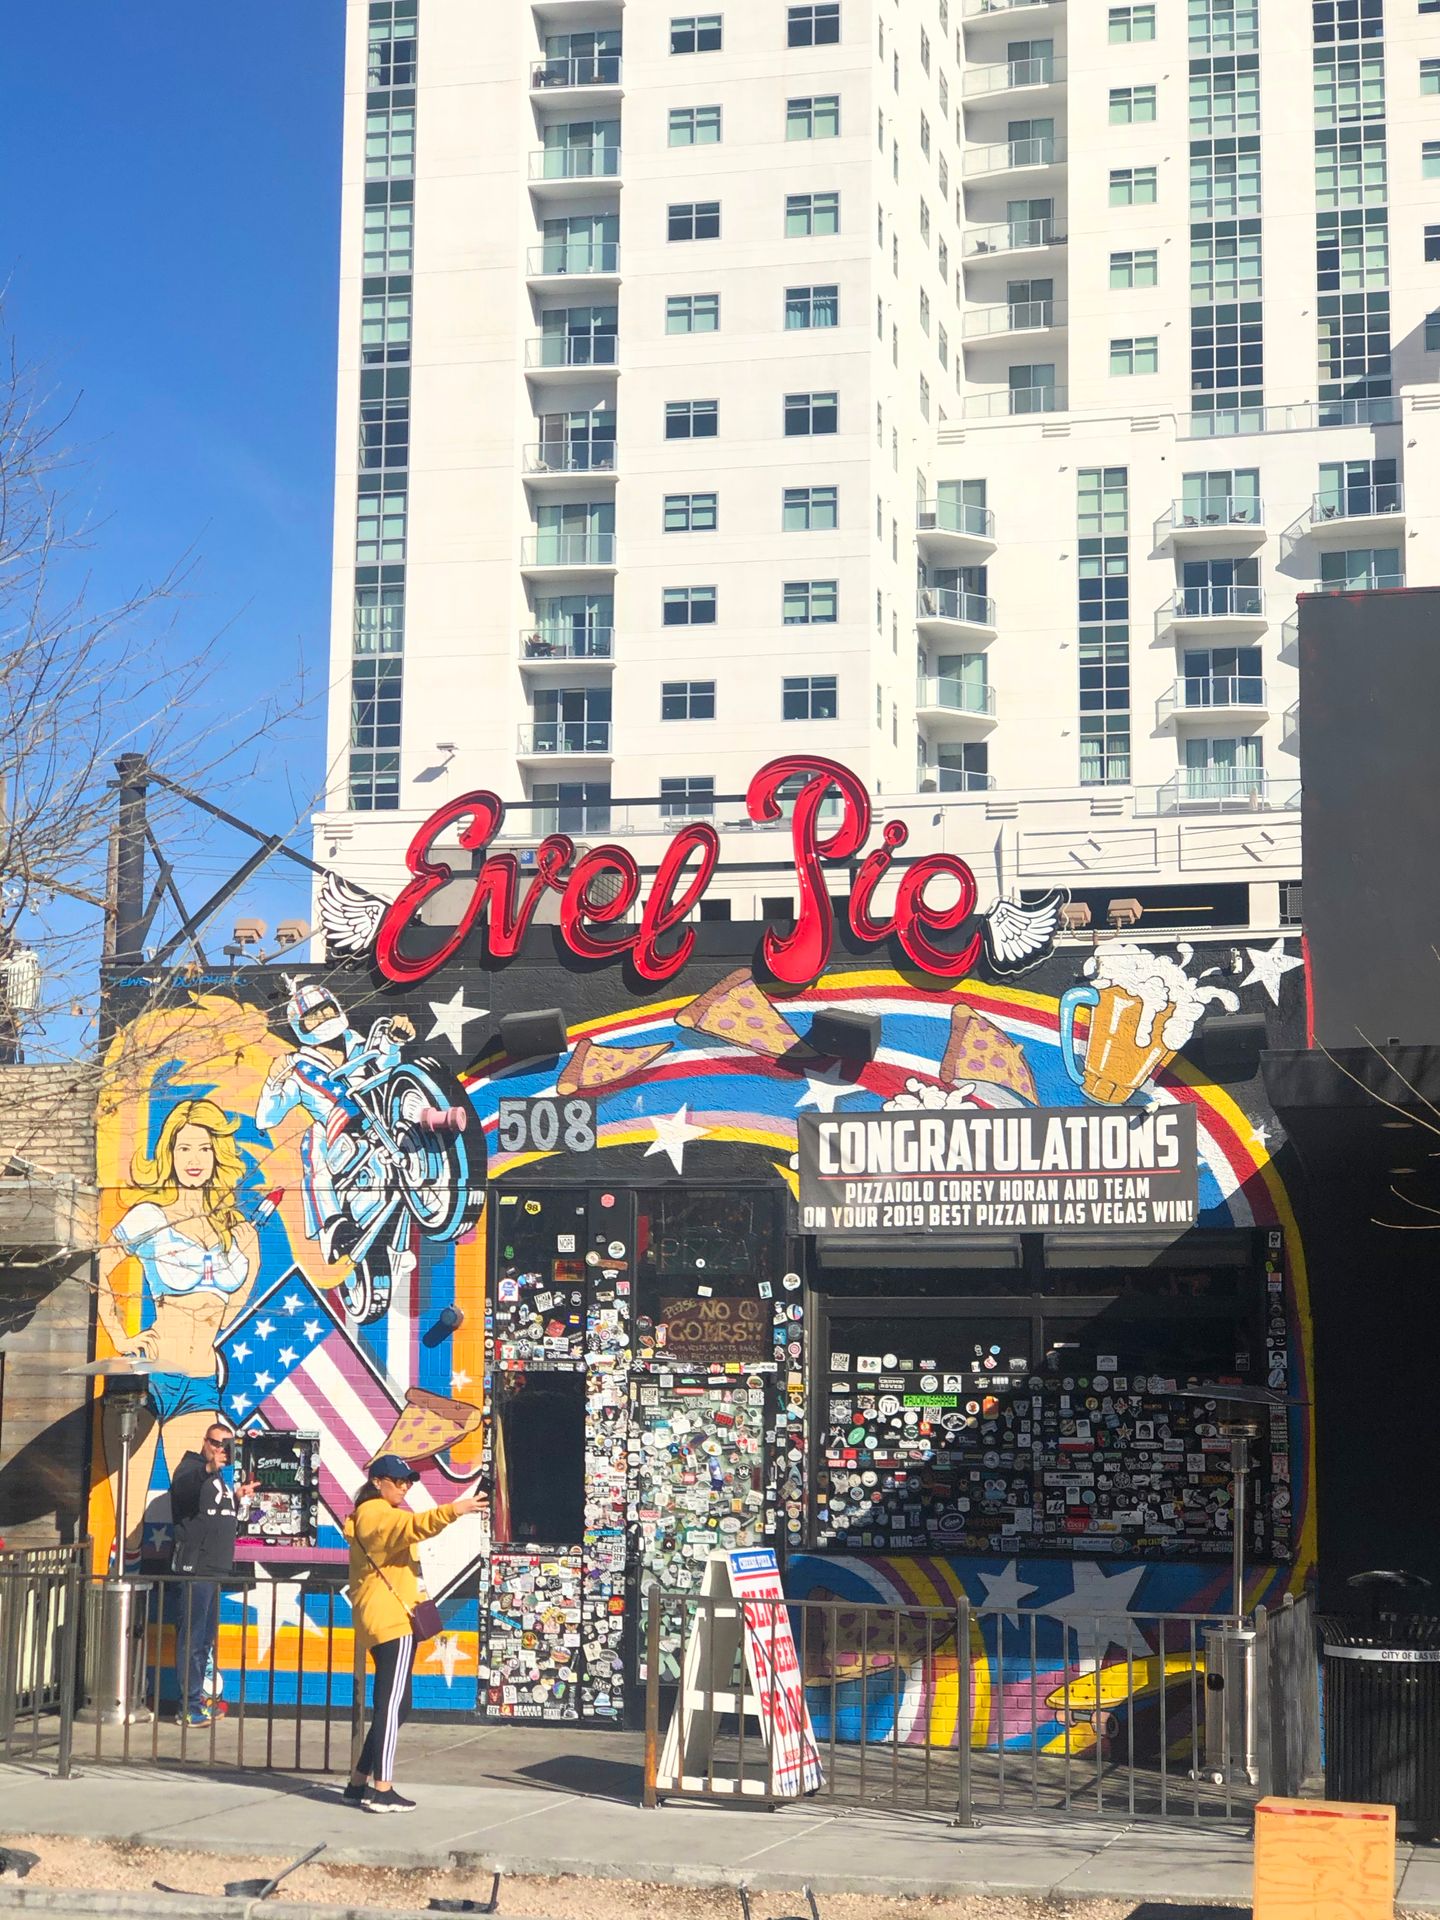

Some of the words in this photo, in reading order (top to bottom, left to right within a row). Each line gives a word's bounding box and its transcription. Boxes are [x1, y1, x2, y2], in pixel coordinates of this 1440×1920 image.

[374, 789, 720, 984] Evel
[746, 754, 983, 985] Pie
[500, 1099, 595, 1153] 508
[817, 1113, 1180, 1175] CONGRATULATIONS
[845, 1180, 934, 1205] PIZZAIOLO
[939, 1179, 995, 1203] COREY
[1000, 1178, 1059, 1202] HORAN
[1064, 1178, 1099, 1201] AND
[1104, 1177, 1150, 1200] TEAM
[803, 1206, 826, 1229] ON
[831, 1206, 879, 1229] YOUR
[882, 1204, 924, 1227] 2019
[929, 1203, 972, 1227] BEST
[976, 1203, 1027, 1226] PIZZA
[1031, 1202, 1050, 1225] IN
[1054, 1201, 1086, 1225] LAS
[1090, 1201, 1149, 1224] VEGAS
[1152, 1200, 1194, 1223] WIN!
[698, 1301, 730, 1320] NO
[257, 1458, 281, 1469] Sorry
[742, 1587, 788, 1630] SLICE
[764, 1635, 799, 1674] BEER
[1381, 1651, 1400, 1660] CITY
[1402, 1652, 1412, 1660] OF
[1414, 1652, 1428, 1660] LAS
